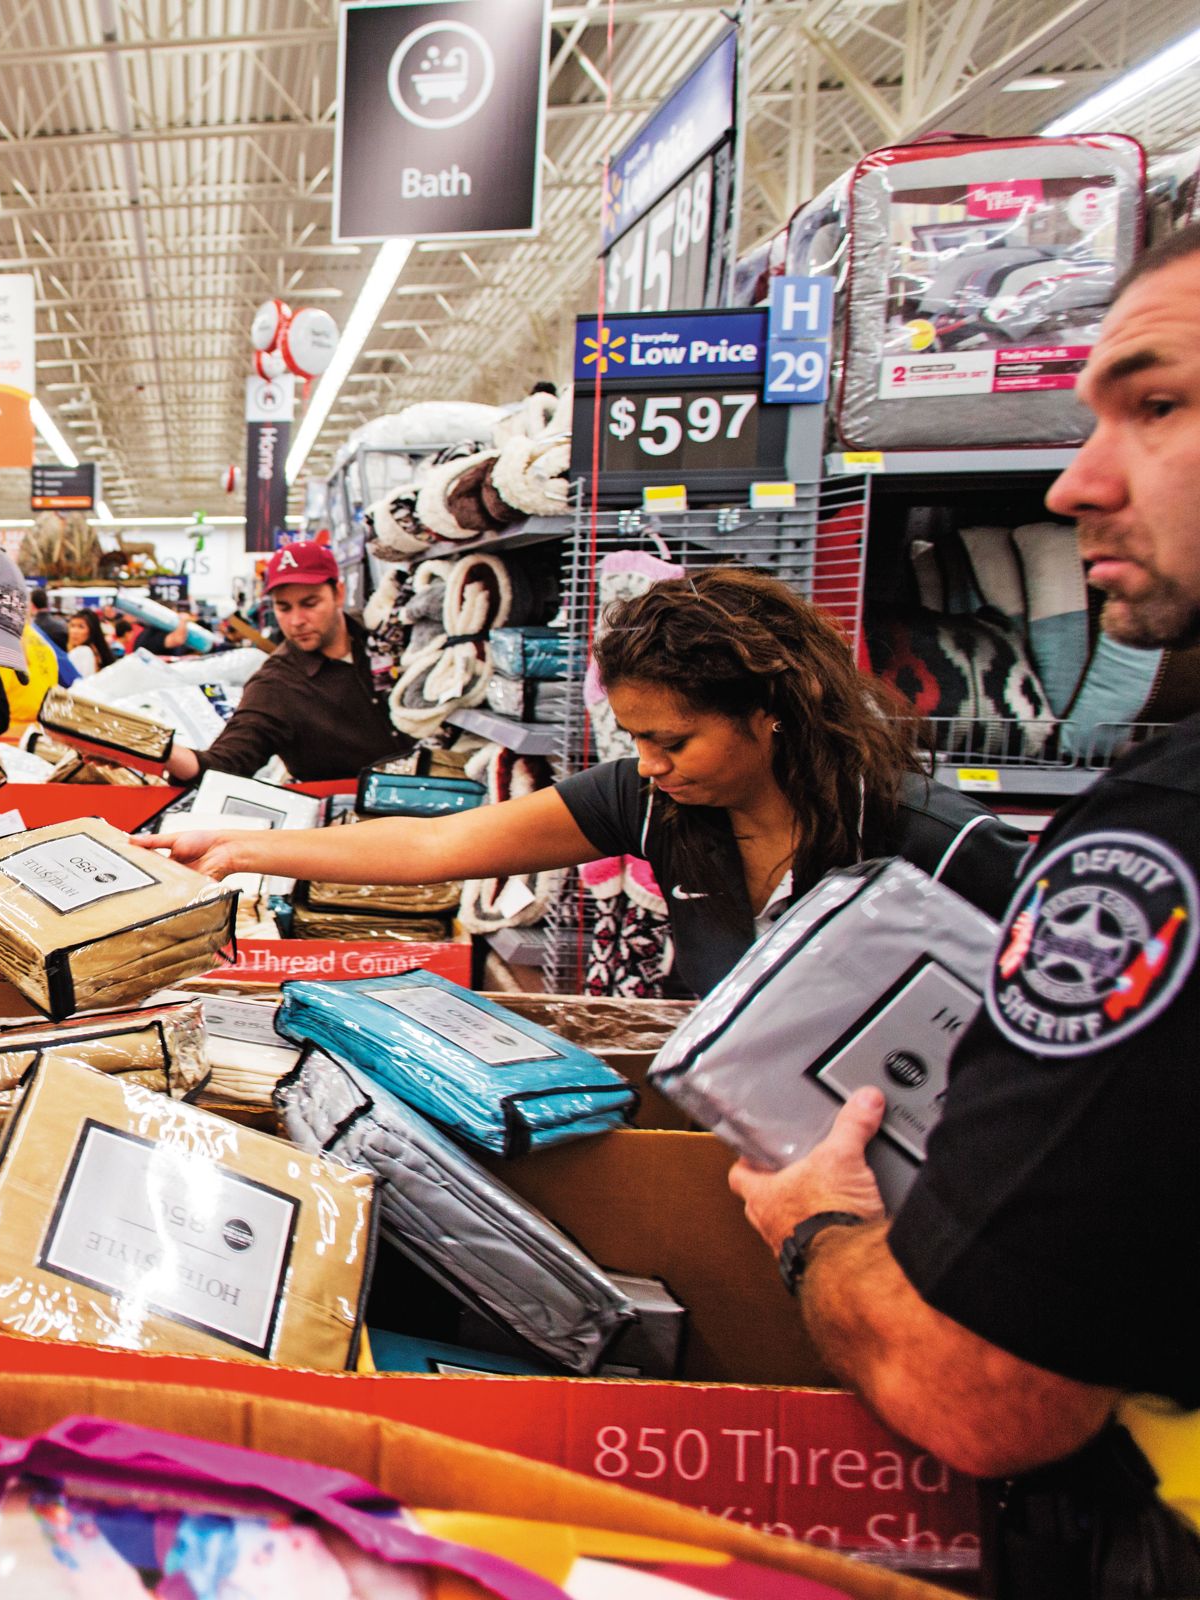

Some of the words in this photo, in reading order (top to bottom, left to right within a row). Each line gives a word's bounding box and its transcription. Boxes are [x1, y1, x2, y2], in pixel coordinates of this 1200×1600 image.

[401, 165, 471, 199] Bath
[622, 164, 655, 218] Low
[653, 118, 695, 184] Price
[781, 284, 821, 331] H
[630, 344, 687, 365] Low
[689, 340, 758, 363] Price
[631, 332, 680, 344] Everyday
[767, 351, 824, 393] 29
[891, 366, 906, 383] 2
[256, 427, 278, 480] Home
[277, 550, 298, 571] A
[155, 585, 180, 601] $15
[69, 855, 98, 875] 850
[1071, 848, 1175, 892] DEPUTY
[250, 949, 335, 975] Thread
[342, 952, 424, 975] Count
[999, 985, 1100, 1040] SHERIFF
[181, 1261, 242, 1306] HOTE
[594, 1425, 710, 1481] 850
[721, 1428, 950, 1493] Thread
